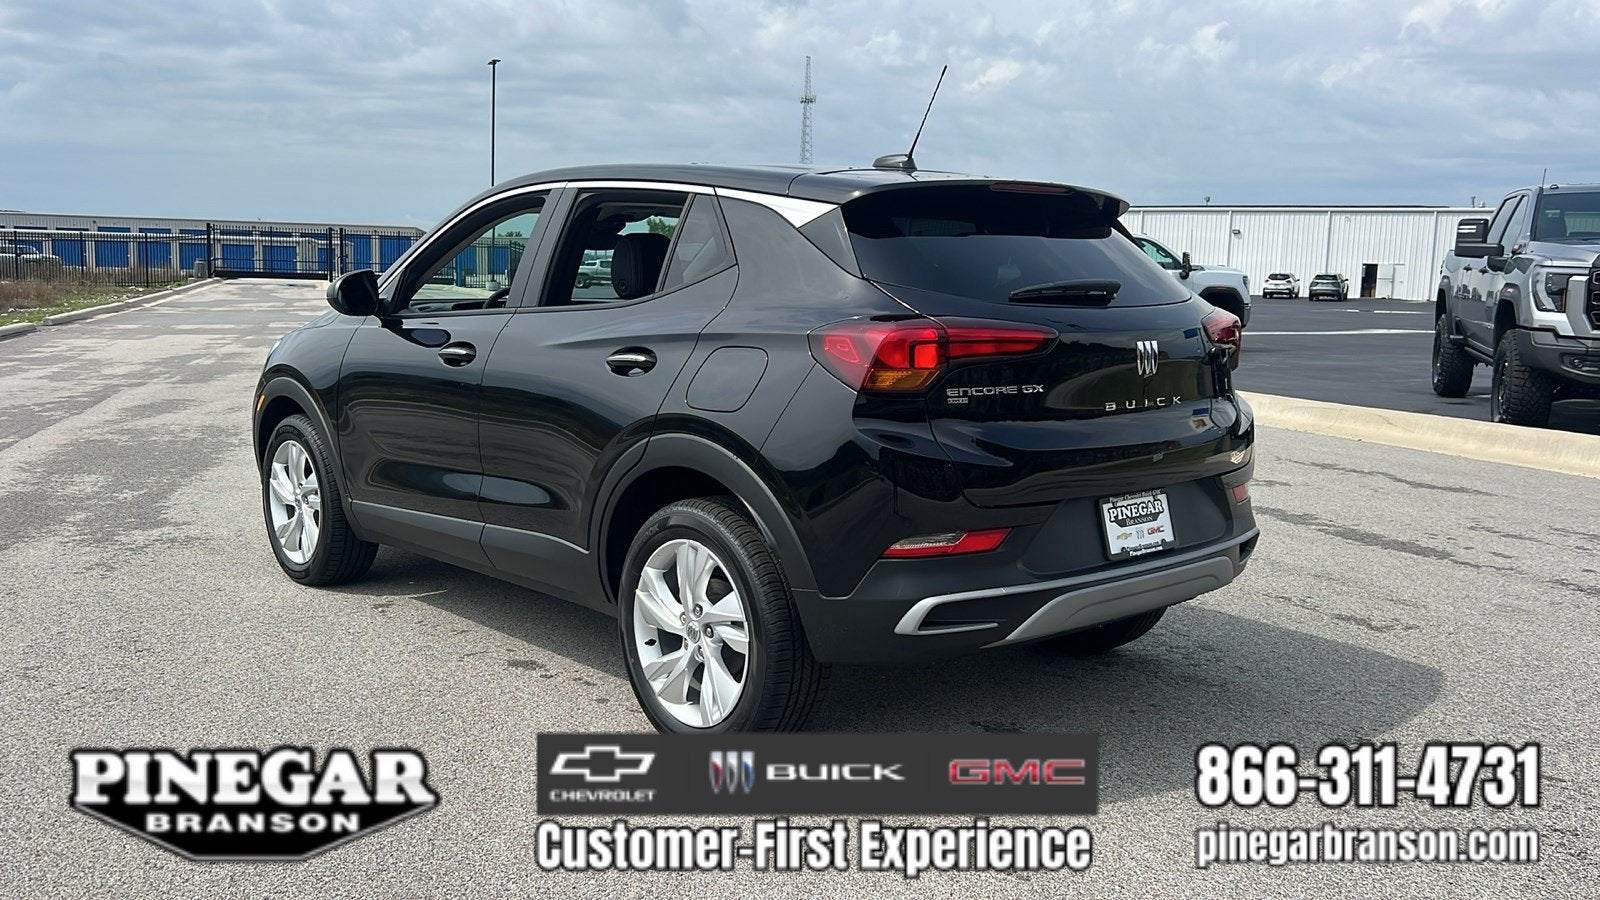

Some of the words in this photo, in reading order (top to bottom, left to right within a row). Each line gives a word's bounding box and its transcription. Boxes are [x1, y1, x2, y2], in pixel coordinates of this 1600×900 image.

[946, 386, 1018, 397] ENCORE
[1022, 384, 1044, 394] GX
[1105, 396, 1182, 411] BUICK
[1109, 500, 1164, 521] PINEGAR
[1147, 525, 1165, 536] GMC
